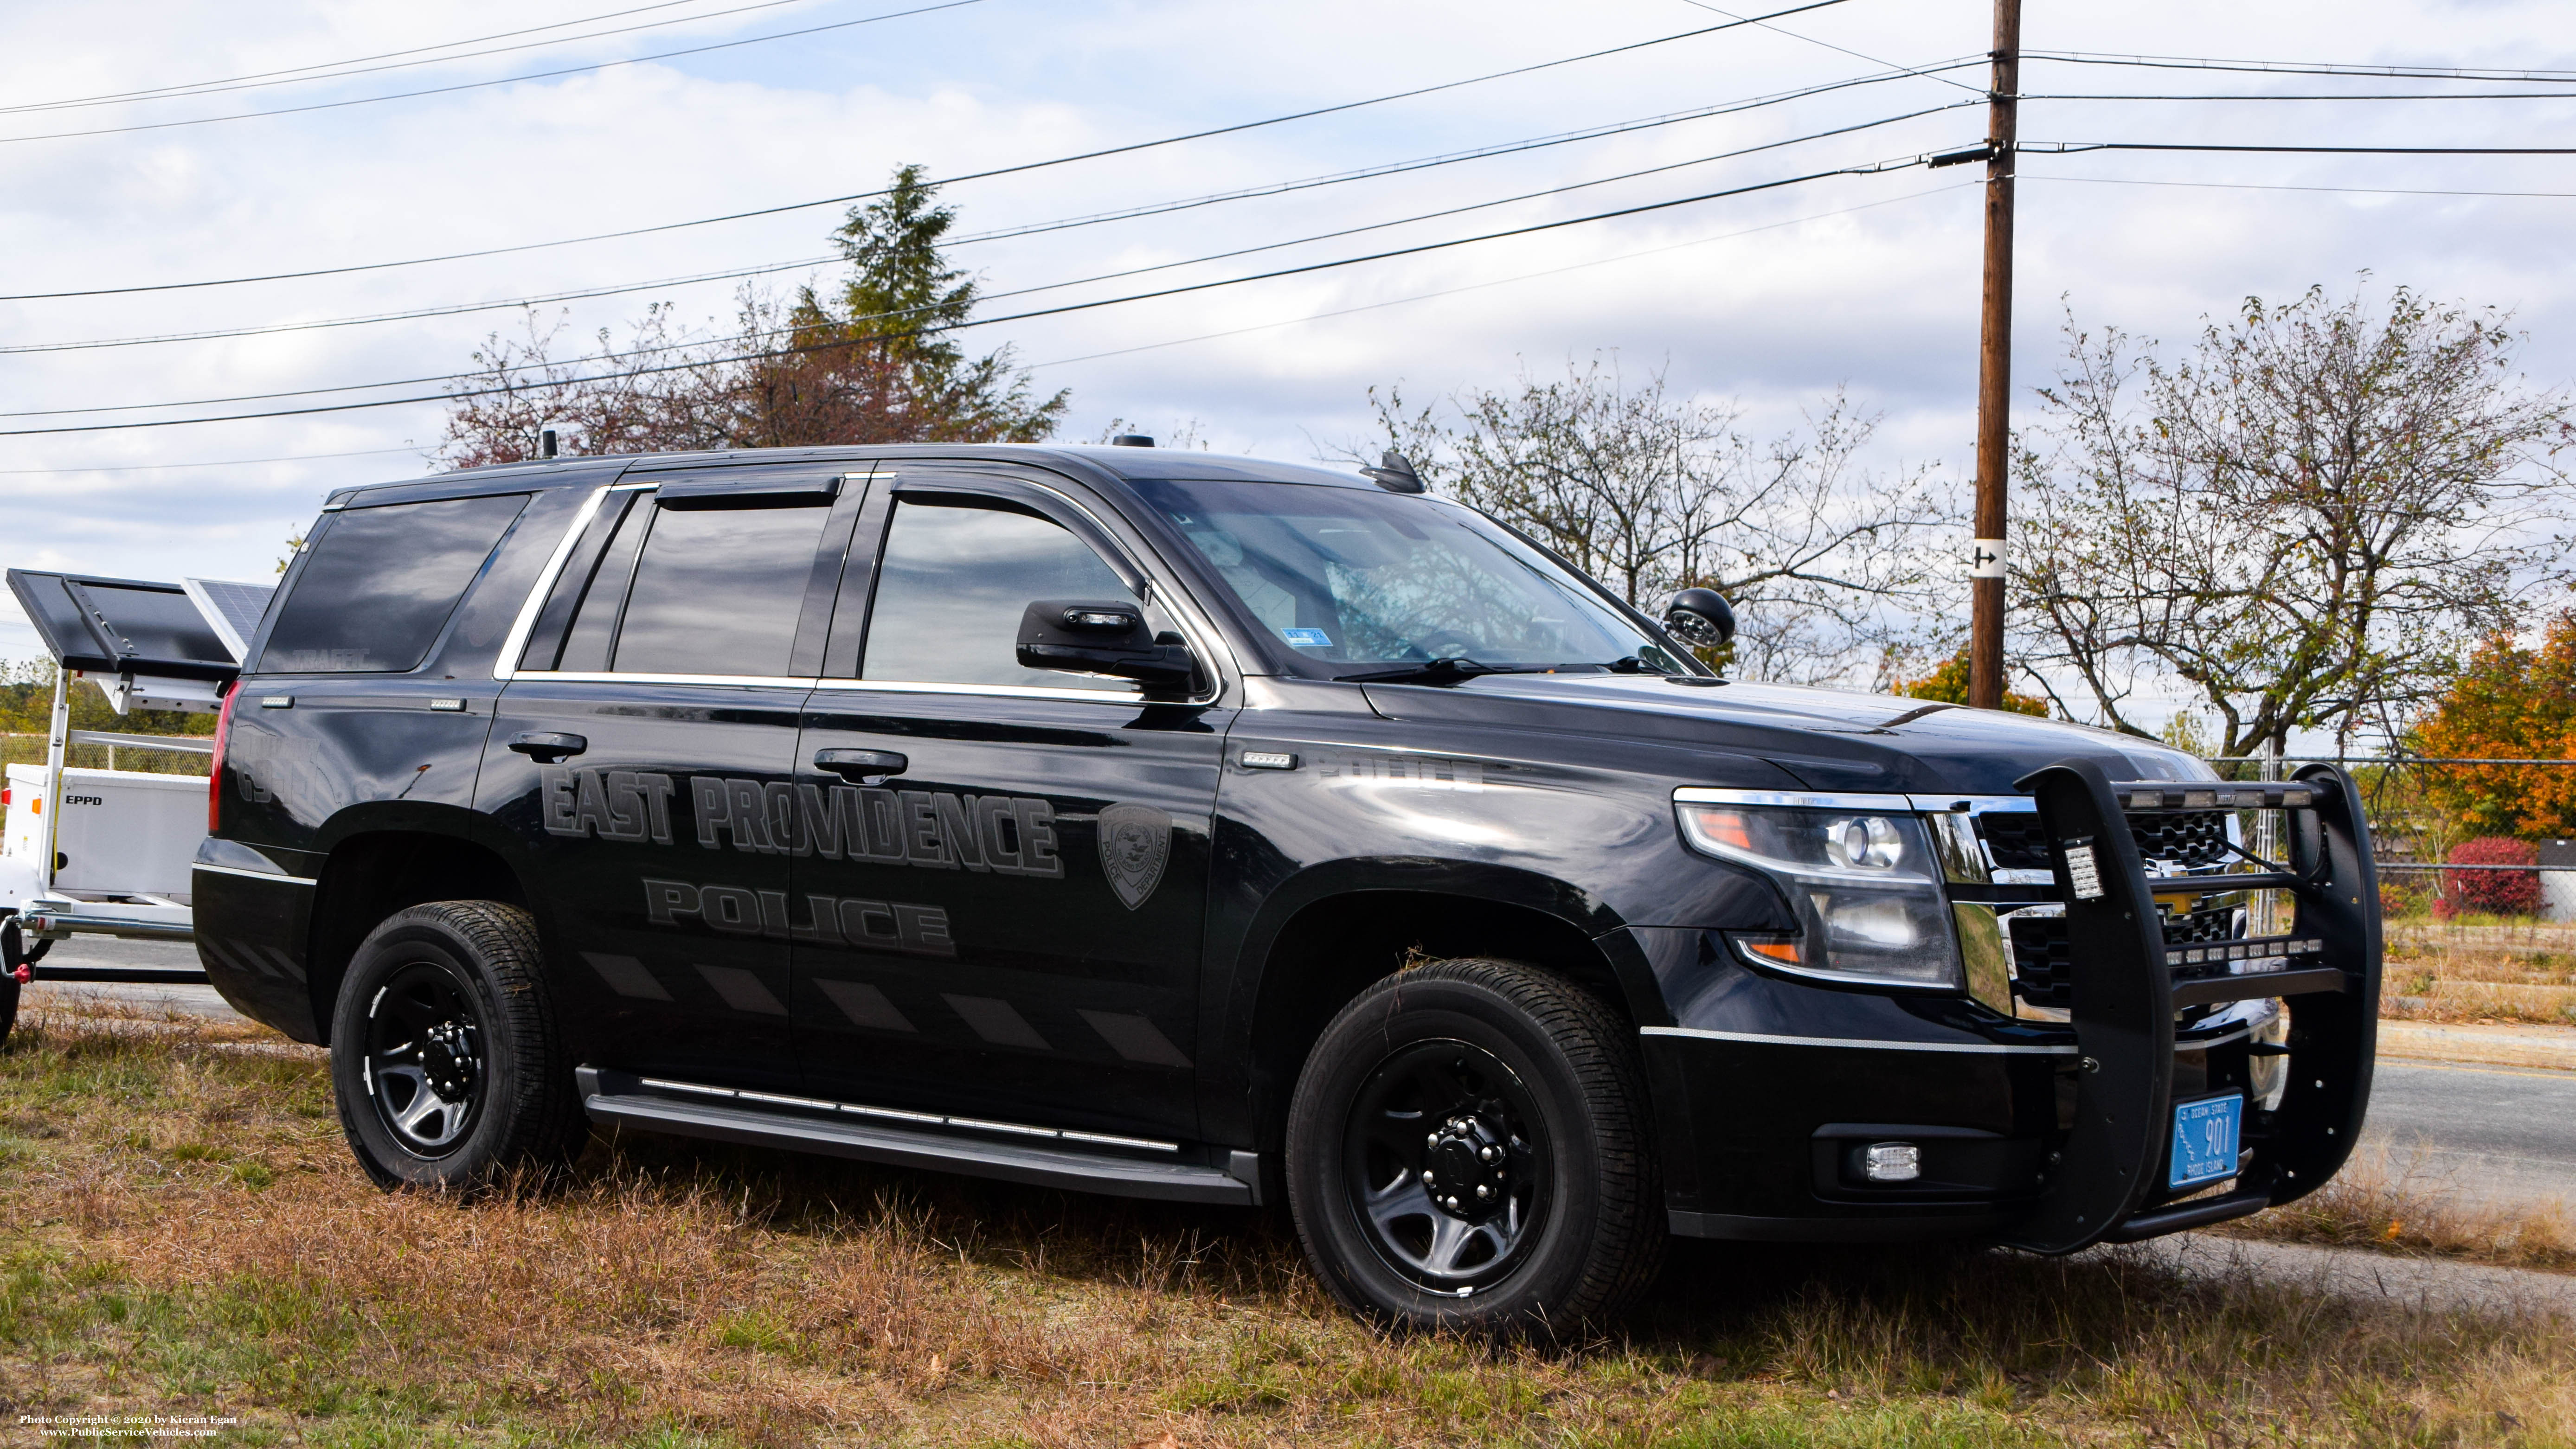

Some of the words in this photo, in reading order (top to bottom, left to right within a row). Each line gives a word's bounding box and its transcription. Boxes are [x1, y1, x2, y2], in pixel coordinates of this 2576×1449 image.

[292, 648, 370, 670] TRAFFIC
[66, 795, 102, 806] EPPD
[541, 767, 675, 845] EAST
[690, 776, 1065, 878] PROVIDENCE
[1103, 841, 1121, 883] POLICE
[1137, 833, 1166, 895] DEPARTMENT
[641, 878, 957, 957] POLICE
[2191, 1108, 2208, 1119] OCEAN
[2211, 1102, 2227, 1116] STATE
[2178, 1124, 2195, 1161] POLICE
[2205, 1115, 2229, 1158] 901
[2187, 1162, 2204, 1176] RHODE
[2206, 1159, 2223, 1173] ISLAND
